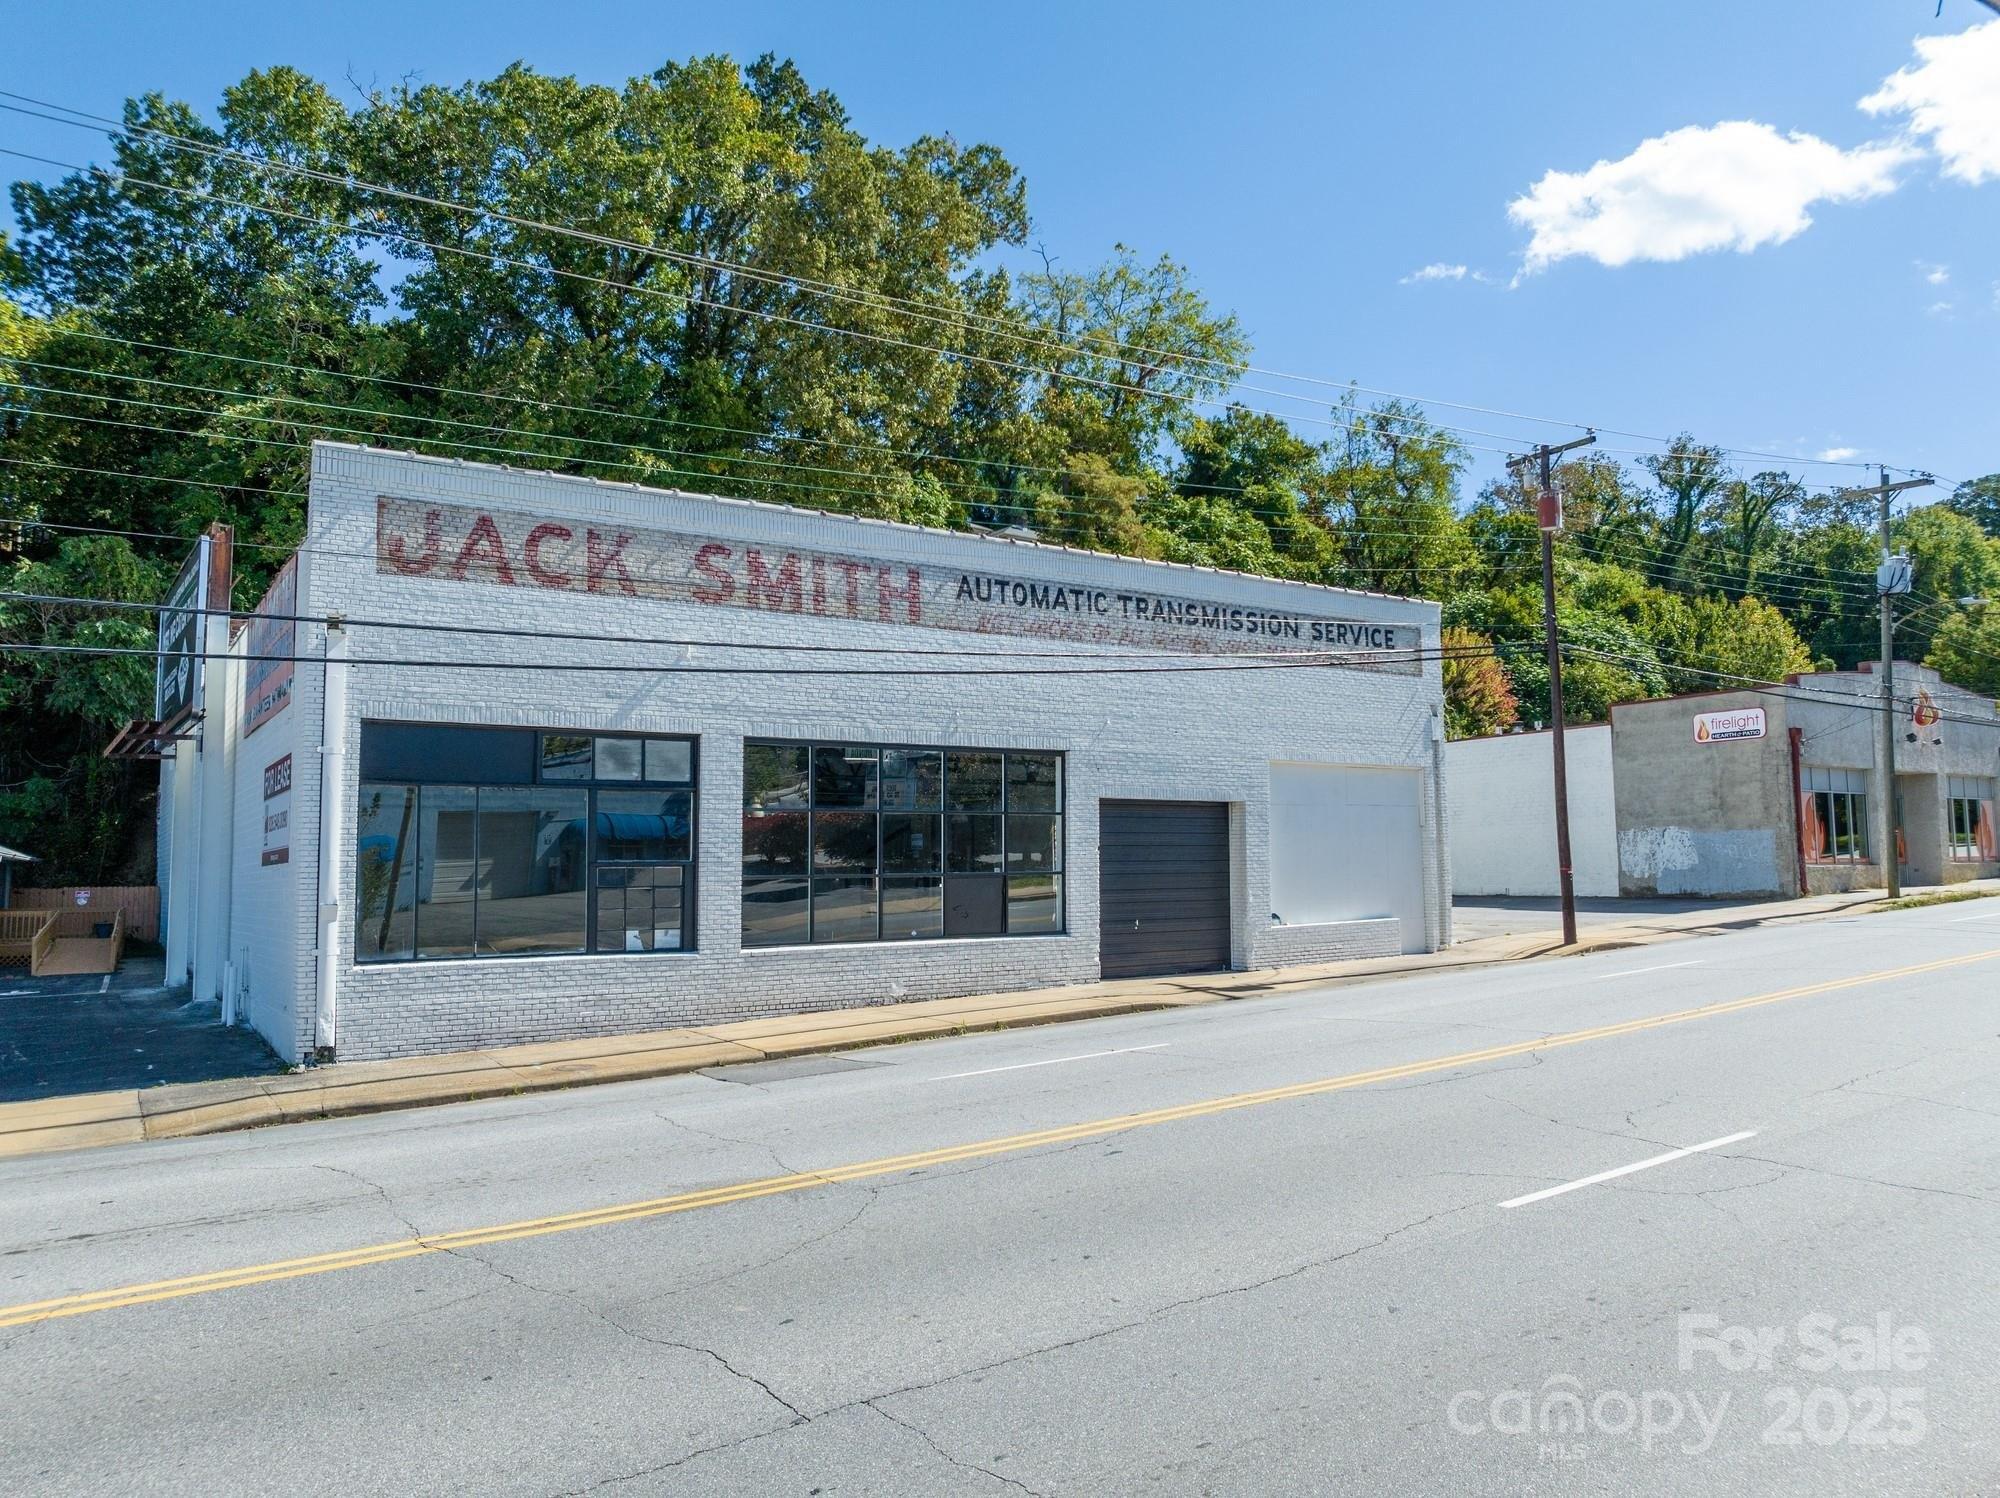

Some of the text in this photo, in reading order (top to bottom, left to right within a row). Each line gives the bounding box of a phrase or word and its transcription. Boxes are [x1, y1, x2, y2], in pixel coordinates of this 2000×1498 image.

[387, 510, 923, 624] JACK SMITH
[957, 574, 1107, 614] AUTOMATIC
[1118, 594, 1299, 640] TRANSMISSION
[1311, 621, 1396, 650] SERVICE
[1711, 714, 1760, 730] firelight
[265, 760, 290, 797] FOR LEASE
